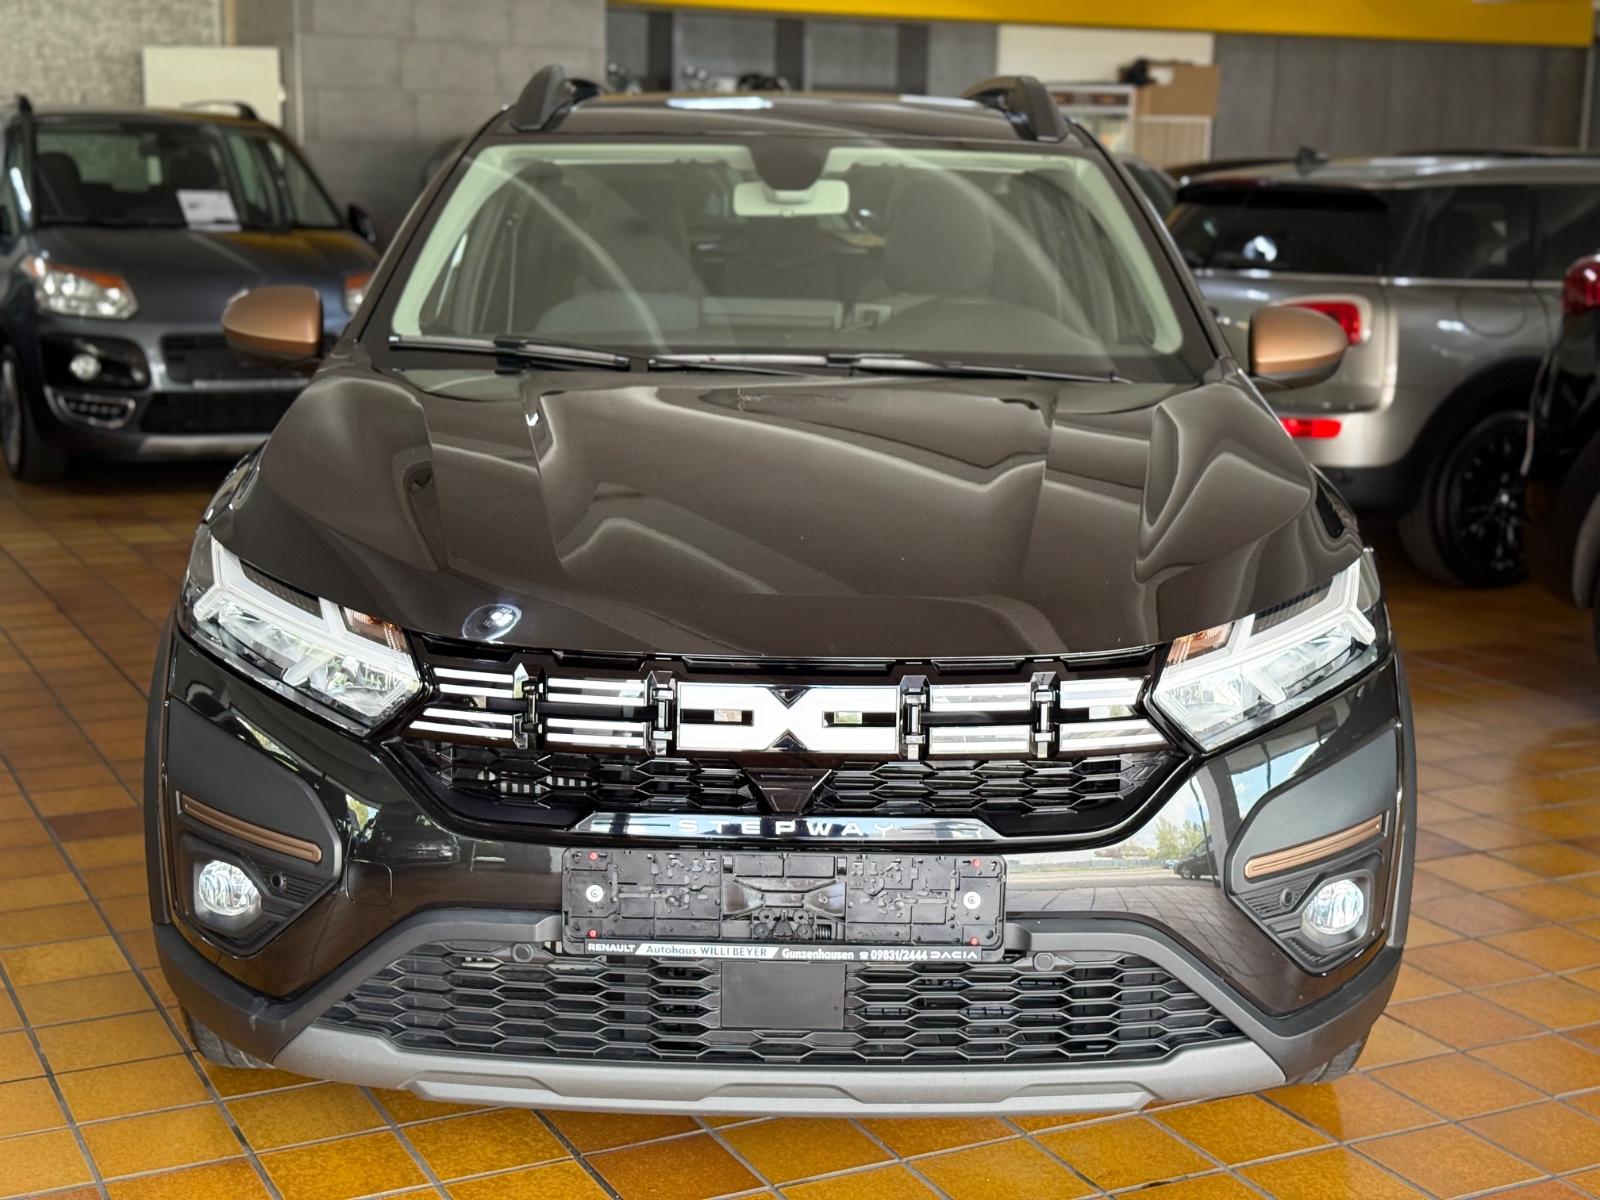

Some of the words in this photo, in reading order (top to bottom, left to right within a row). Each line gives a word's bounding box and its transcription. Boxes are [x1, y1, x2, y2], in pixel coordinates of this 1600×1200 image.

[678, 819, 895, 838] STEPWAY
[587, 943, 636, 953] RENAULT
[646, 944, 697, 955] Autohaus
[700, 946, 730, 956] WILLI
[733, 947, 767, 957] BEYER
[781, 948, 855, 961] Gunzenhausen
[870, 949, 928, 961] 09831/2444
[930, 950, 978, 960] DACIA
